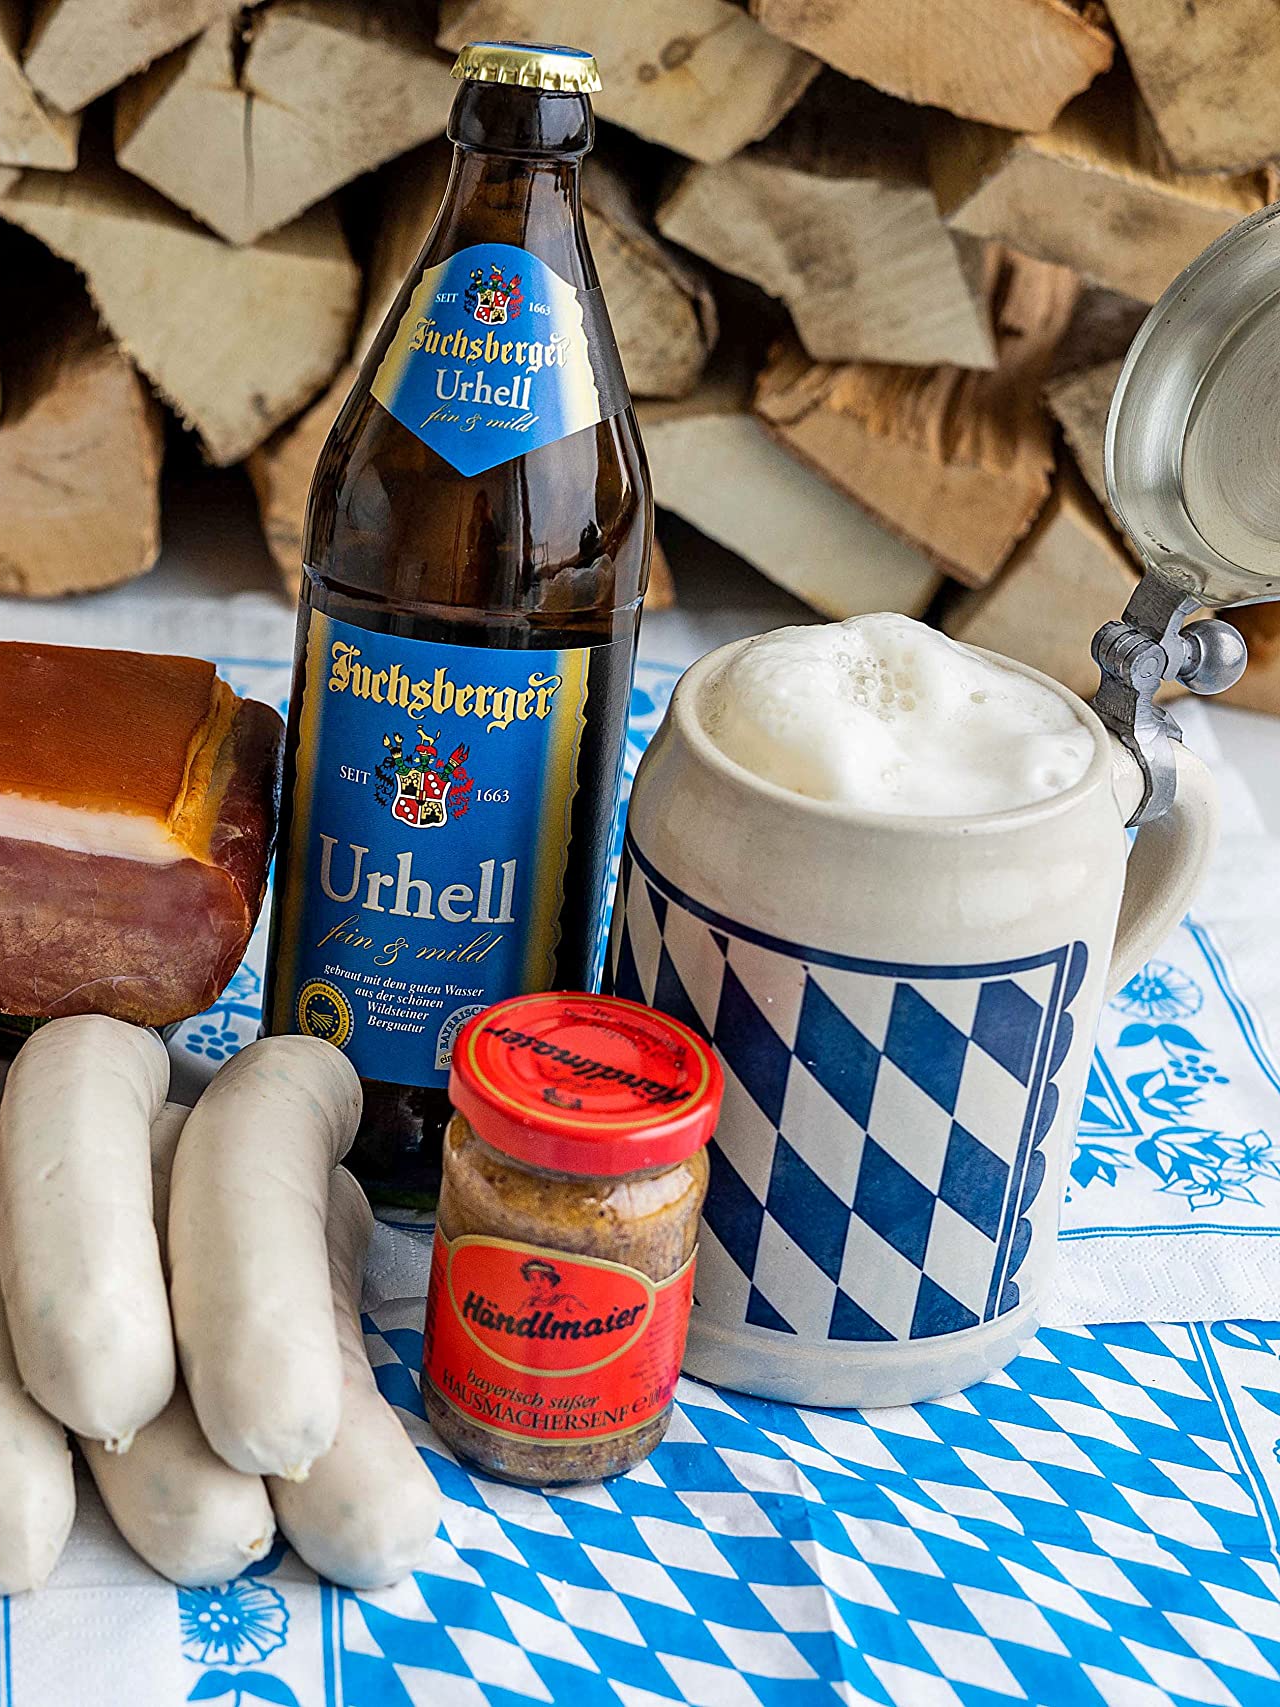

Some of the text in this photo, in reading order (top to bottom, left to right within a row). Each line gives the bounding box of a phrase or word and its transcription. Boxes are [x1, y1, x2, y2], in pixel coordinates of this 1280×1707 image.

[434, 292, 552, 316] SEIT 1663
[408, 317, 571, 375] Fuchsberger
[435, 368, 533, 411] Urhell
[420, 403, 540, 433] fein & mild
[328, 641, 563, 734] Fuchsberger
[339, 765, 510, 804] SEIT 1663
[320, 833, 517, 924] Urhell
[317, 914, 503, 966] fein & mild
[324, 964, 484, 997] gebraut mit dem guten Wasser
[354, 986, 444, 1009] aus der schönen
[367, 1001, 430, 1021] Wildsteiner
[367, 1015, 426, 1034] Bergnatur
[483, 1027, 692, 1106] Händlmaier
[462, 1290, 648, 1341] Händlmaier
[443, 1367, 630, 1431] HAUSMACHERSENF
[466, 1368, 602, 1414] bayerisch süßer
